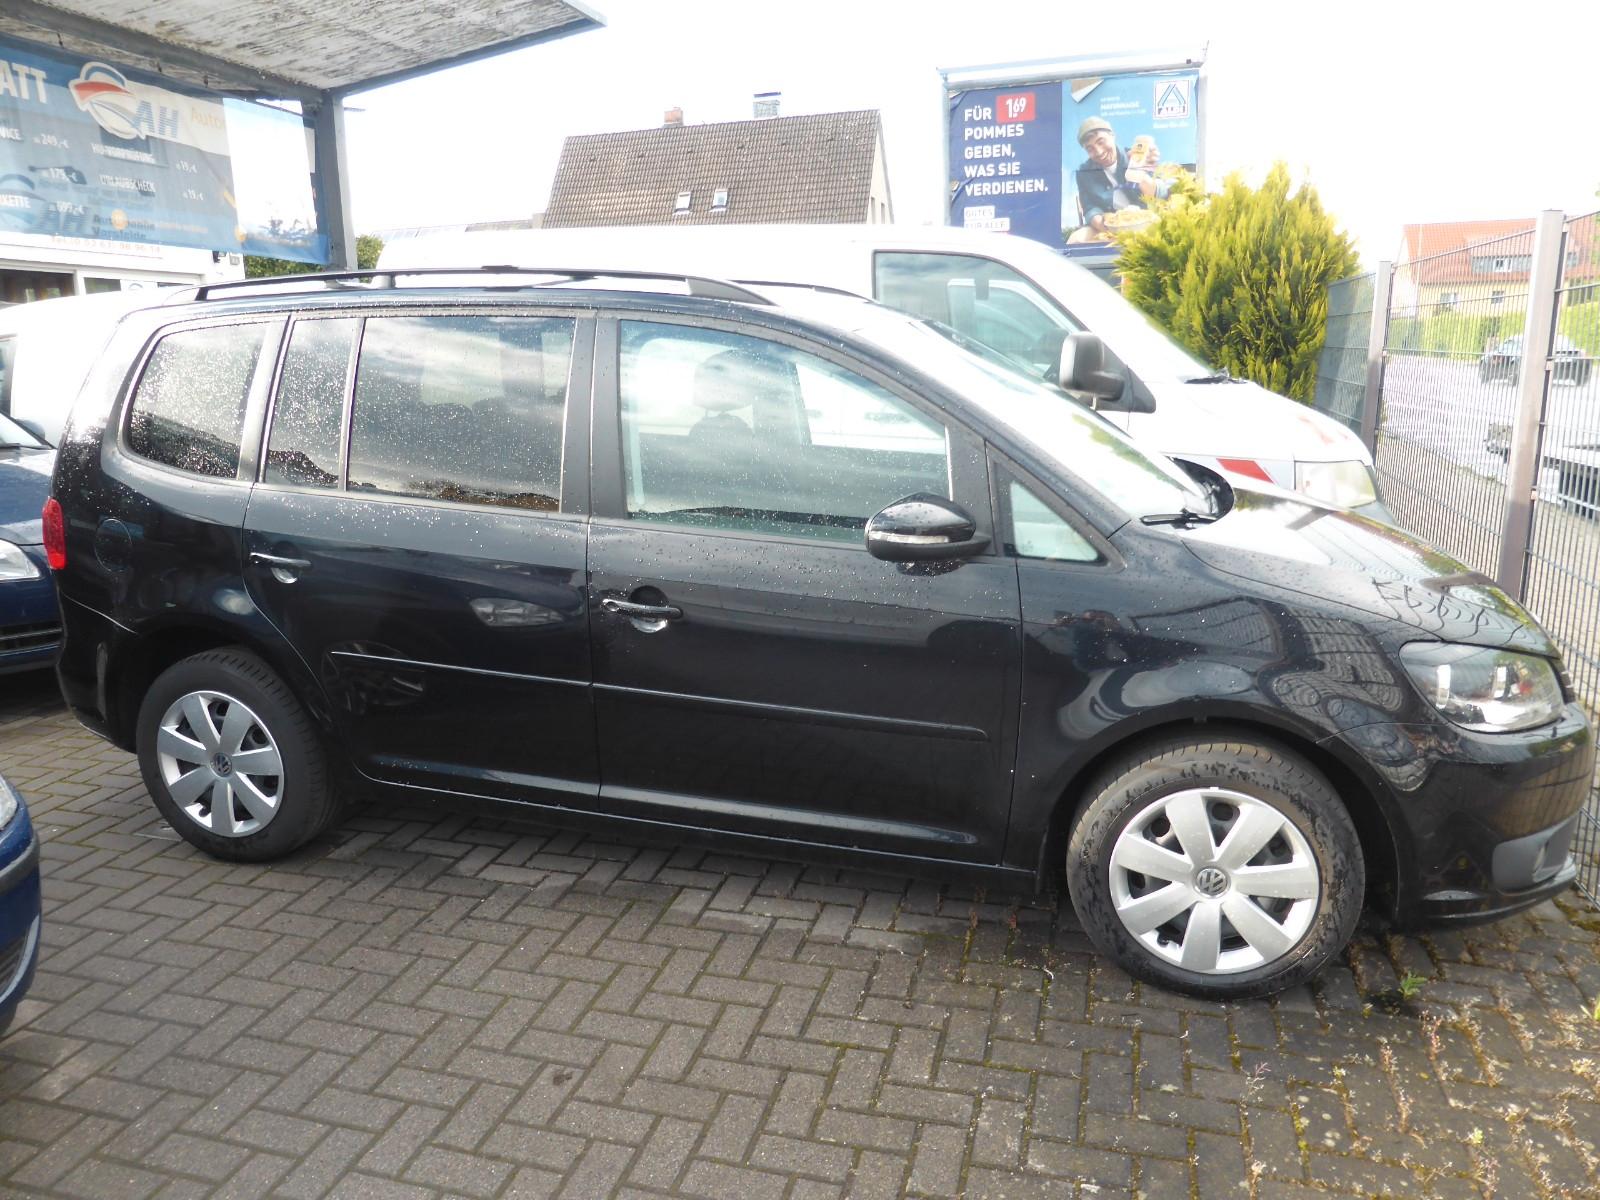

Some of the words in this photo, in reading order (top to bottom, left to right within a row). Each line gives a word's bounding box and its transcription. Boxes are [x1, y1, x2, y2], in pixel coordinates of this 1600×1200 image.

[133, 101, 179, 138] AH
[964, 105, 992, 121] FÜR
[964, 124, 1024, 141] POMMES
[964, 144, 1016, 159] GEBEN,
[964, 163, 995, 178] WAS
[998, 161, 1020, 176] SIE
[965, 178, 1049, 197] VERDIENEN.
